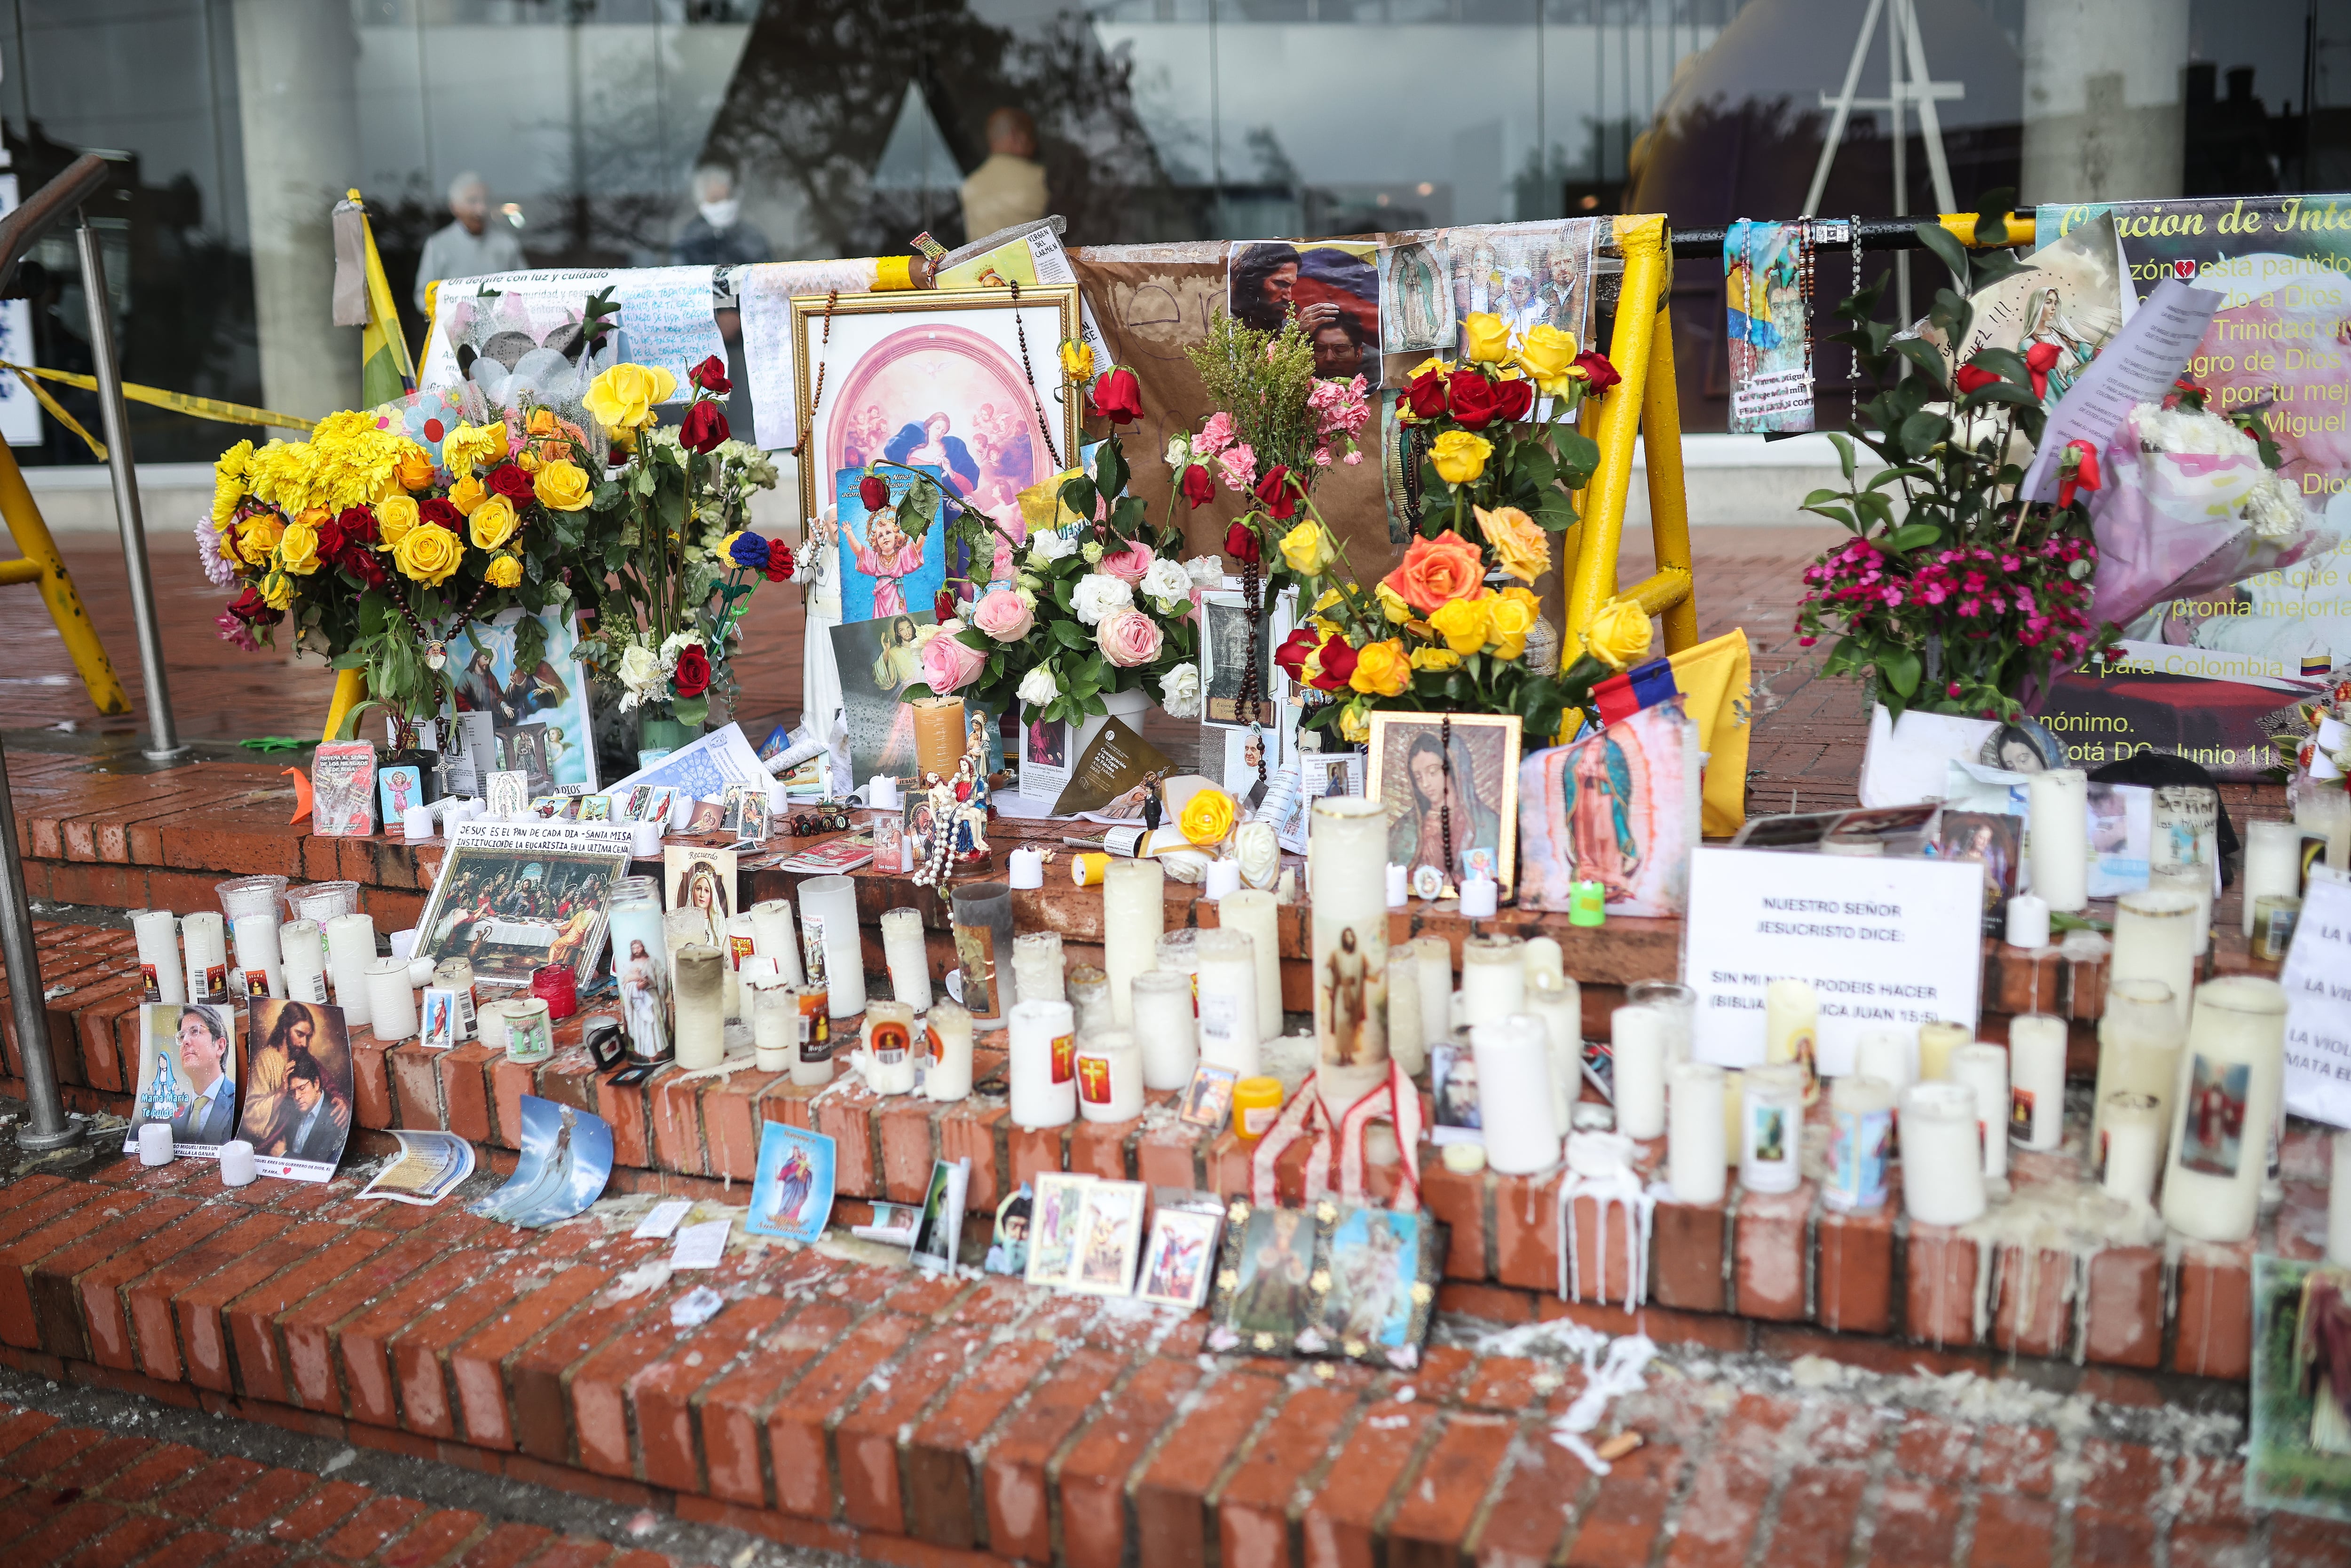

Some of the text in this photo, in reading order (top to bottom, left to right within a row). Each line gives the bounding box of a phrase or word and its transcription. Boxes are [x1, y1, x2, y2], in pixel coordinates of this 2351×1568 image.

[2217, 199, 2261, 234] de
[1027, 229, 1049, 242] VIRGEN
[1035, 244, 1057, 258] CARMEN
[2200, 256, 2252, 277] está
[2264, 252, 2351, 281] partido
[532, 272, 548, 281] luz
[562, 271, 608, 280] cuidado
[444, 294, 459, 303] Por
[2260, 285, 2342, 307] a Dios
[2213, 317, 2321, 340] Trinidad
[2244, 350, 2275, 371] de
[2286, 348, 2341, 370] Dios
[2222, 386, 2264, 408] por
[2272, 384, 2294, 401] tu
[2264, 411, 2345, 437] Miguel
[2291, 571, 2338, 591] que
[2172, 598, 2252, 621] pronta
[2100, 658, 2154, 678] para
[2165, 655, 2283, 677] Colombia
[2030, 712, 2135, 733] nónimo.
[1101, 747, 1127, 769] Consagración
[1105, 756, 1119, 769] Virgen
[2247, 744, 2271, 765] 11
[1089, 764, 1100, 774] 2025
[1100, 759, 1114, 773] Fátima
[1101, 766, 1115, 779] Jubilar
[561, 785, 580, 794] DIOS
[2157, 816, 2173, 828] Los
[460, 826, 486, 836] JESUS
[490, 827, 500, 836] ES
[513, 827, 527, 837] PAN
[530, 828, 540, 837] DE
[565, 829, 578, 838] DIA
[610, 831, 631, 841] MISA
[525, 841, 568, 850] EUCARISTIA
[587, 844, 611, 853] ULTIMA
[613, 845, 628, 853] CENA
[688, 851, 718, 861] Recuerdo
[1763, 898, 1901, 917] NUESTRO SEÑOR
[1758, 921, 1905, 943] JESUCRISTO DICE:
[2321, 925, 2341, 942] LA
[1711, 971, 1738, 985] SIN
[1743, 973, 1760, 985] MI
[1815, 978, 1875, 994] PODEIS
[1880, 985, 1937, 999] HACER
[2305, 978, 2325, 994] LA
[1853, 1005, 1894, 1021] JUAN
[2289, 1028, 2309, 1045] LA
[2286, 1052, 2331, 1076] MATA
[141, 1092, 189, 1103] Mama María
[142, 1108, 173, 1117] Te cuide
